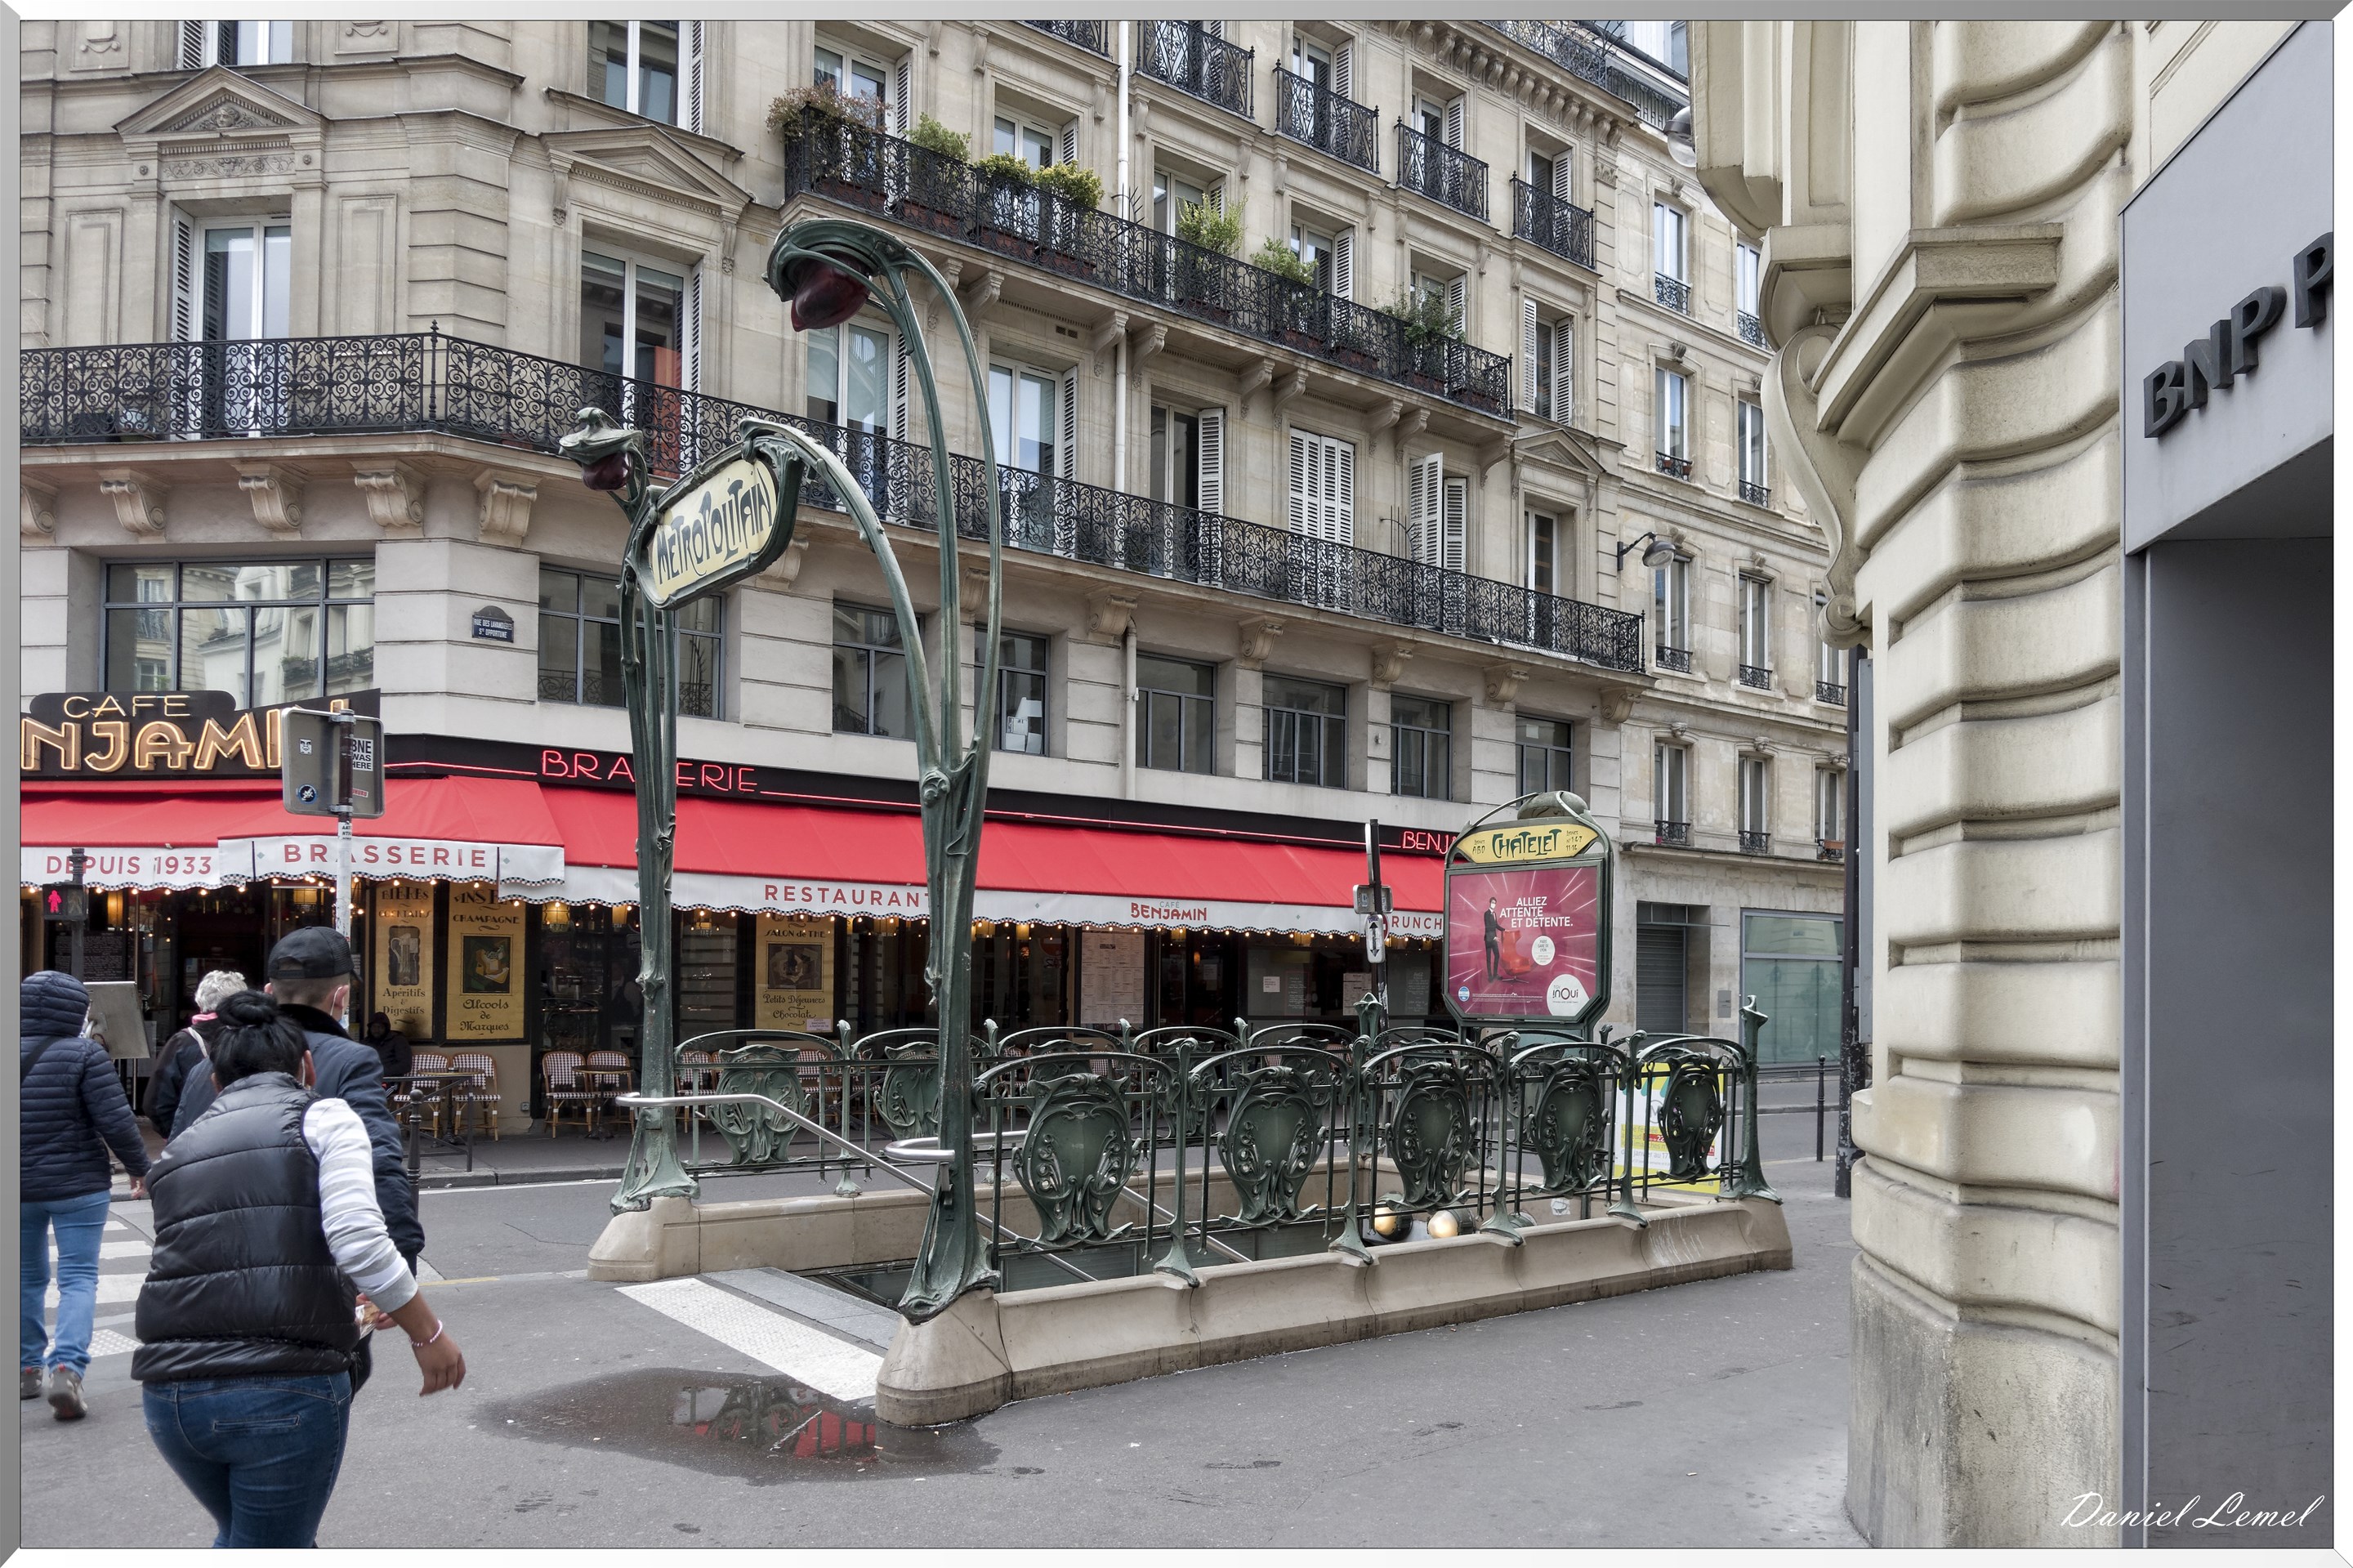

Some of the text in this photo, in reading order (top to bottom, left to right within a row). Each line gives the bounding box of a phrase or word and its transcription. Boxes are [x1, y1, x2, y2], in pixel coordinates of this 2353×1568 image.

[2143, 286, 2287, 439] BNP
[656, 468, 773, 584] METROPOLITAIN
[21, 699, 350, 771] NJAMI
[542, 749, 758, 792] BRAERIE
[1492, 829, 1562, 858] CHÂTELET
[155, 855, 212, 875] 1933
[453, 888, 486, 905] VINS
[765, 884, 929, 908] RESTAURAN
[1516, 896, 1547, 906] ALLIEZ
[1159, 900, 1180, 909] CAFÉ
[1131, 902, 1207, 921] BENJAMIN
[1499, 906, 1543, 918] ATTENTE
[453, 914, 520, 924] CHAMPAGNE
[1391, 915, 1443, 930] RUNCH
[1511, 916, 1574, 927] ET DÉTENTE.
[764, 929, 795, 937] SALON
[796, 929, 806, 938] de
[382, 987, 426, 998] Apéritifs
[462, 998, 509, 1009] Alcools
[762, 993, 826, 1007] Petits Déjeuners
[382, 1006, 425, 1016] Digestifs
[480, 1010, 490, 1020] de
[459, 1021, 510, 1034] Marques
